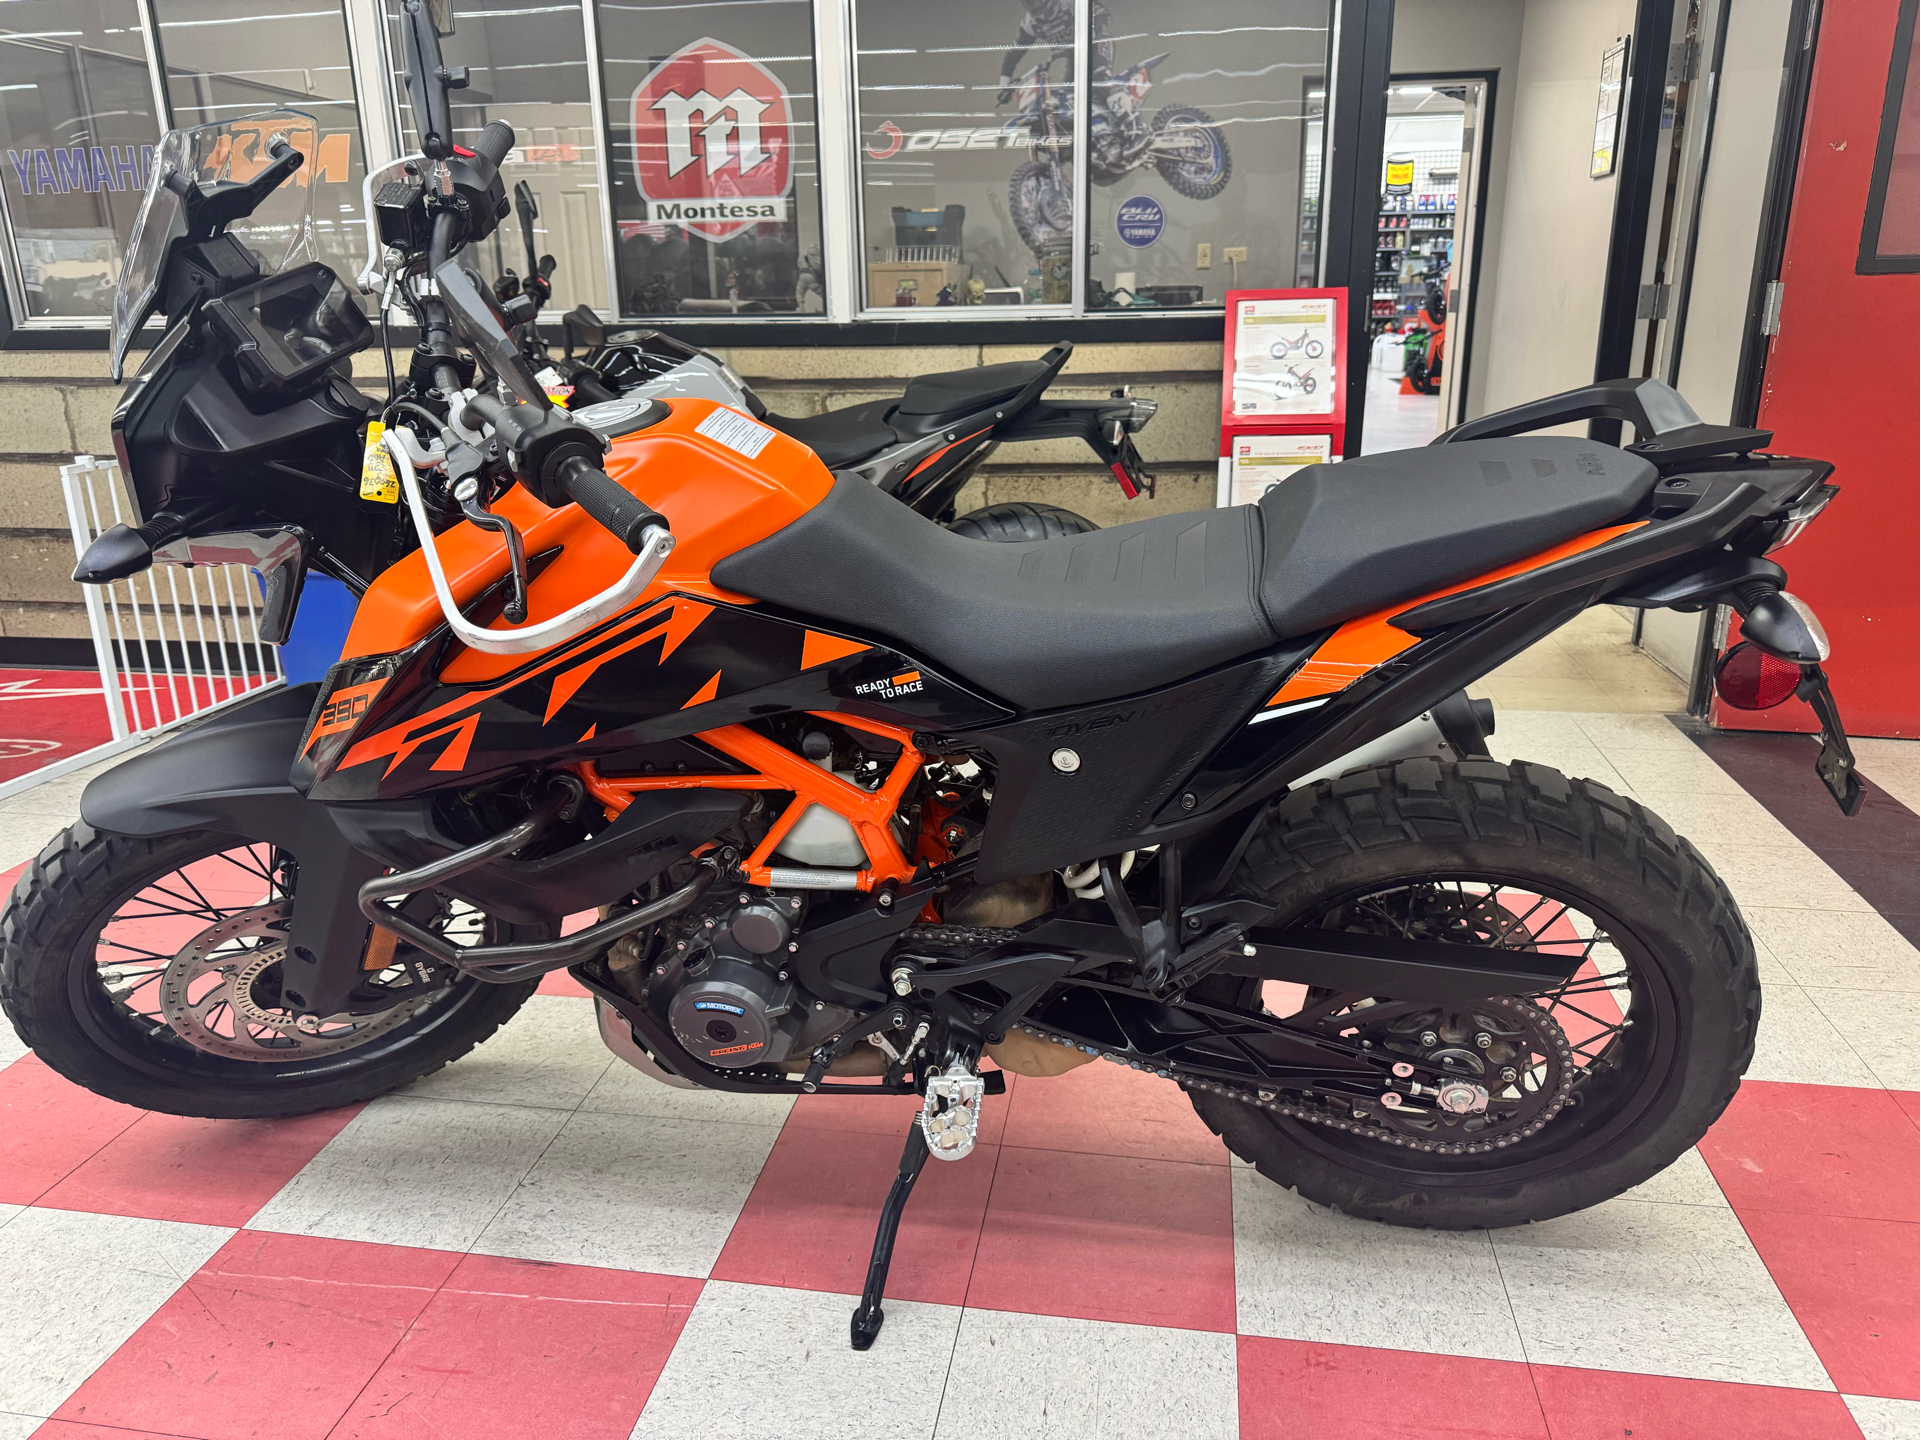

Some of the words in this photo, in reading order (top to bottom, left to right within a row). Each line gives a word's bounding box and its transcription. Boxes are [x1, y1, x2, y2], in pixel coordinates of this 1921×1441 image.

[904, 126, 1031, 152] OSET
[1015, 136, 1073, 148] BIKES
[656, 203, 776, 220] Montesa
[855, 678, 890, 695] READY
[879, 688, 894, 699] TO
[894, 681, 924, 696] RACE
[322, 694, 368, 727] 390
[706, 1002, 742, 1014] MOTOREX
